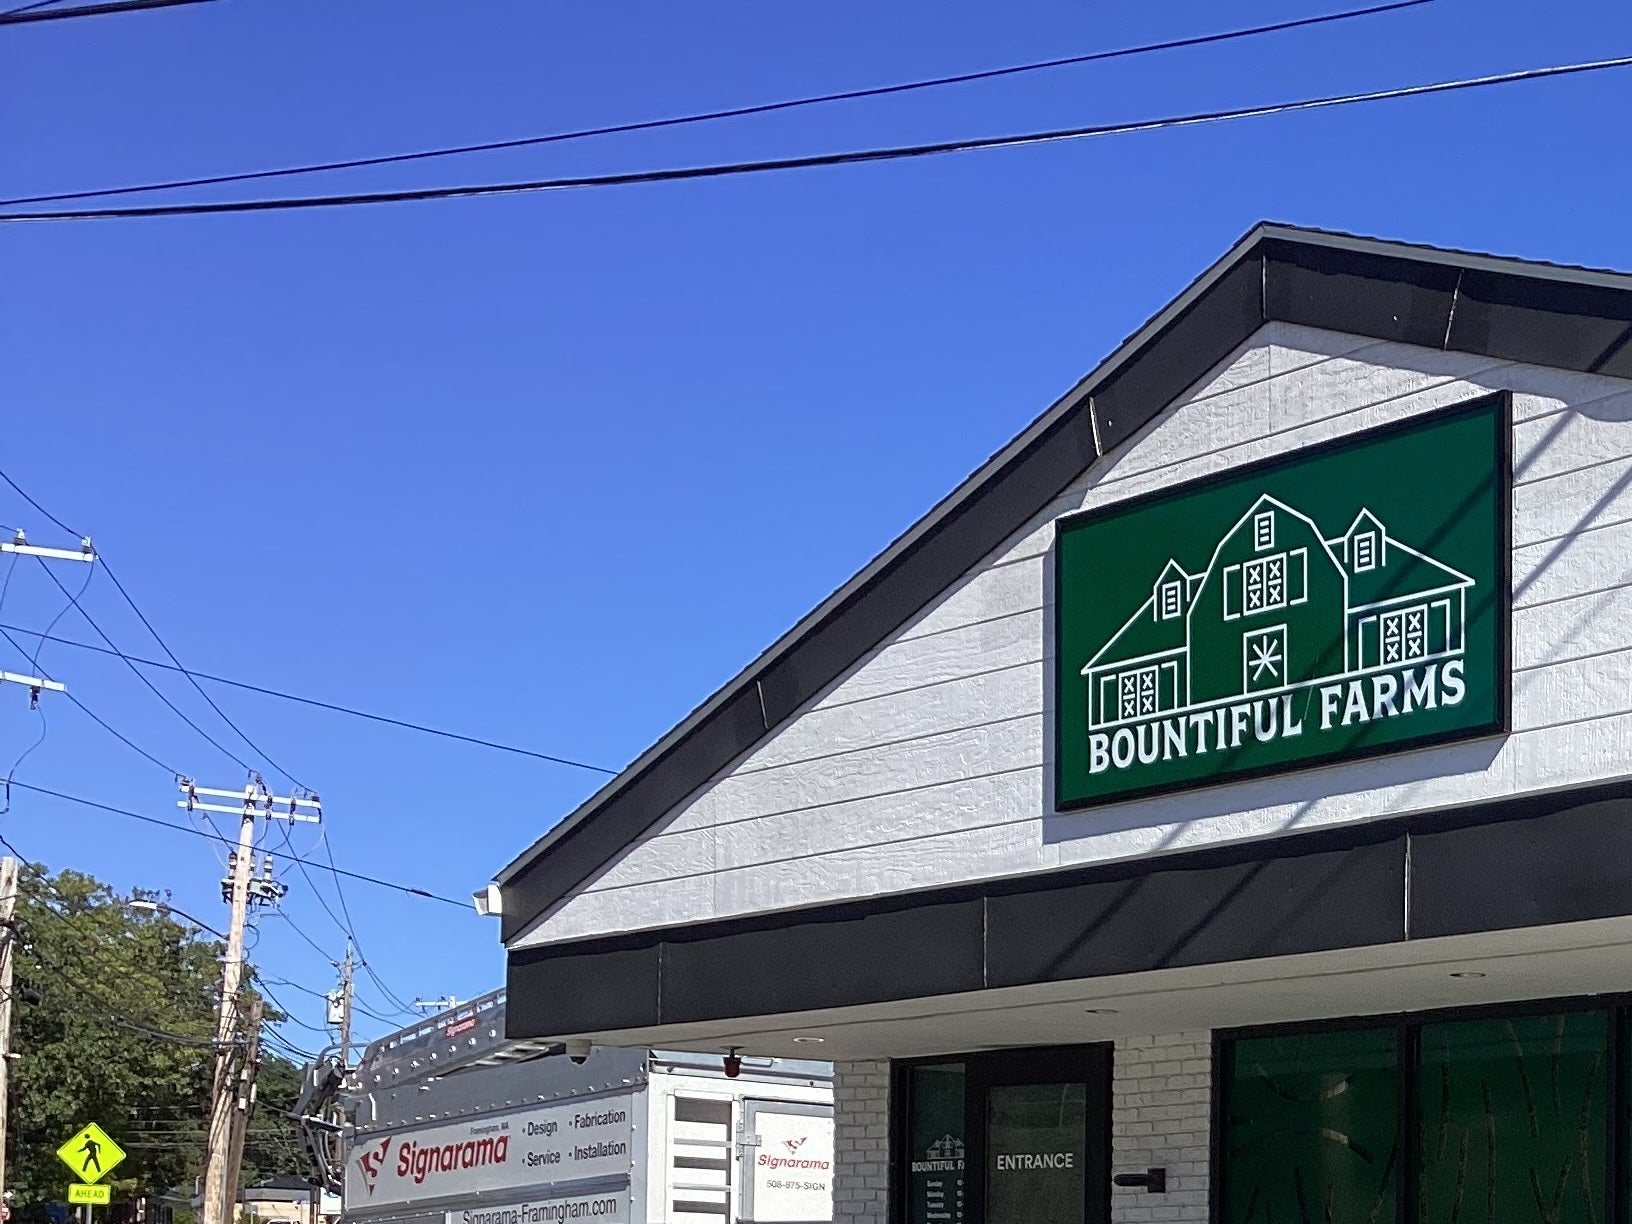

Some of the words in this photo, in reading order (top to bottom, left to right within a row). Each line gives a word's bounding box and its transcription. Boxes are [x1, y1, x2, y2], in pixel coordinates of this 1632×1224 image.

[1088, 694, 1302, 774] BOUNTIFUL
[1319, 659, 1466, 730] FARMS
[527, 1119, 558, 1137] Design
[574, 1109, 626, 1129] Fabrication
[397, 1135, 509, 1184] Signarama
[527, 1149, 561, 1167] Service
[574, 1140, 626, 1161] Installation
[757, 1154, 830, 1170] Signarama
[997, 1153, 1073, 1170] ENTRANCE
[75, 1189, 105, 1199] AHEAD
